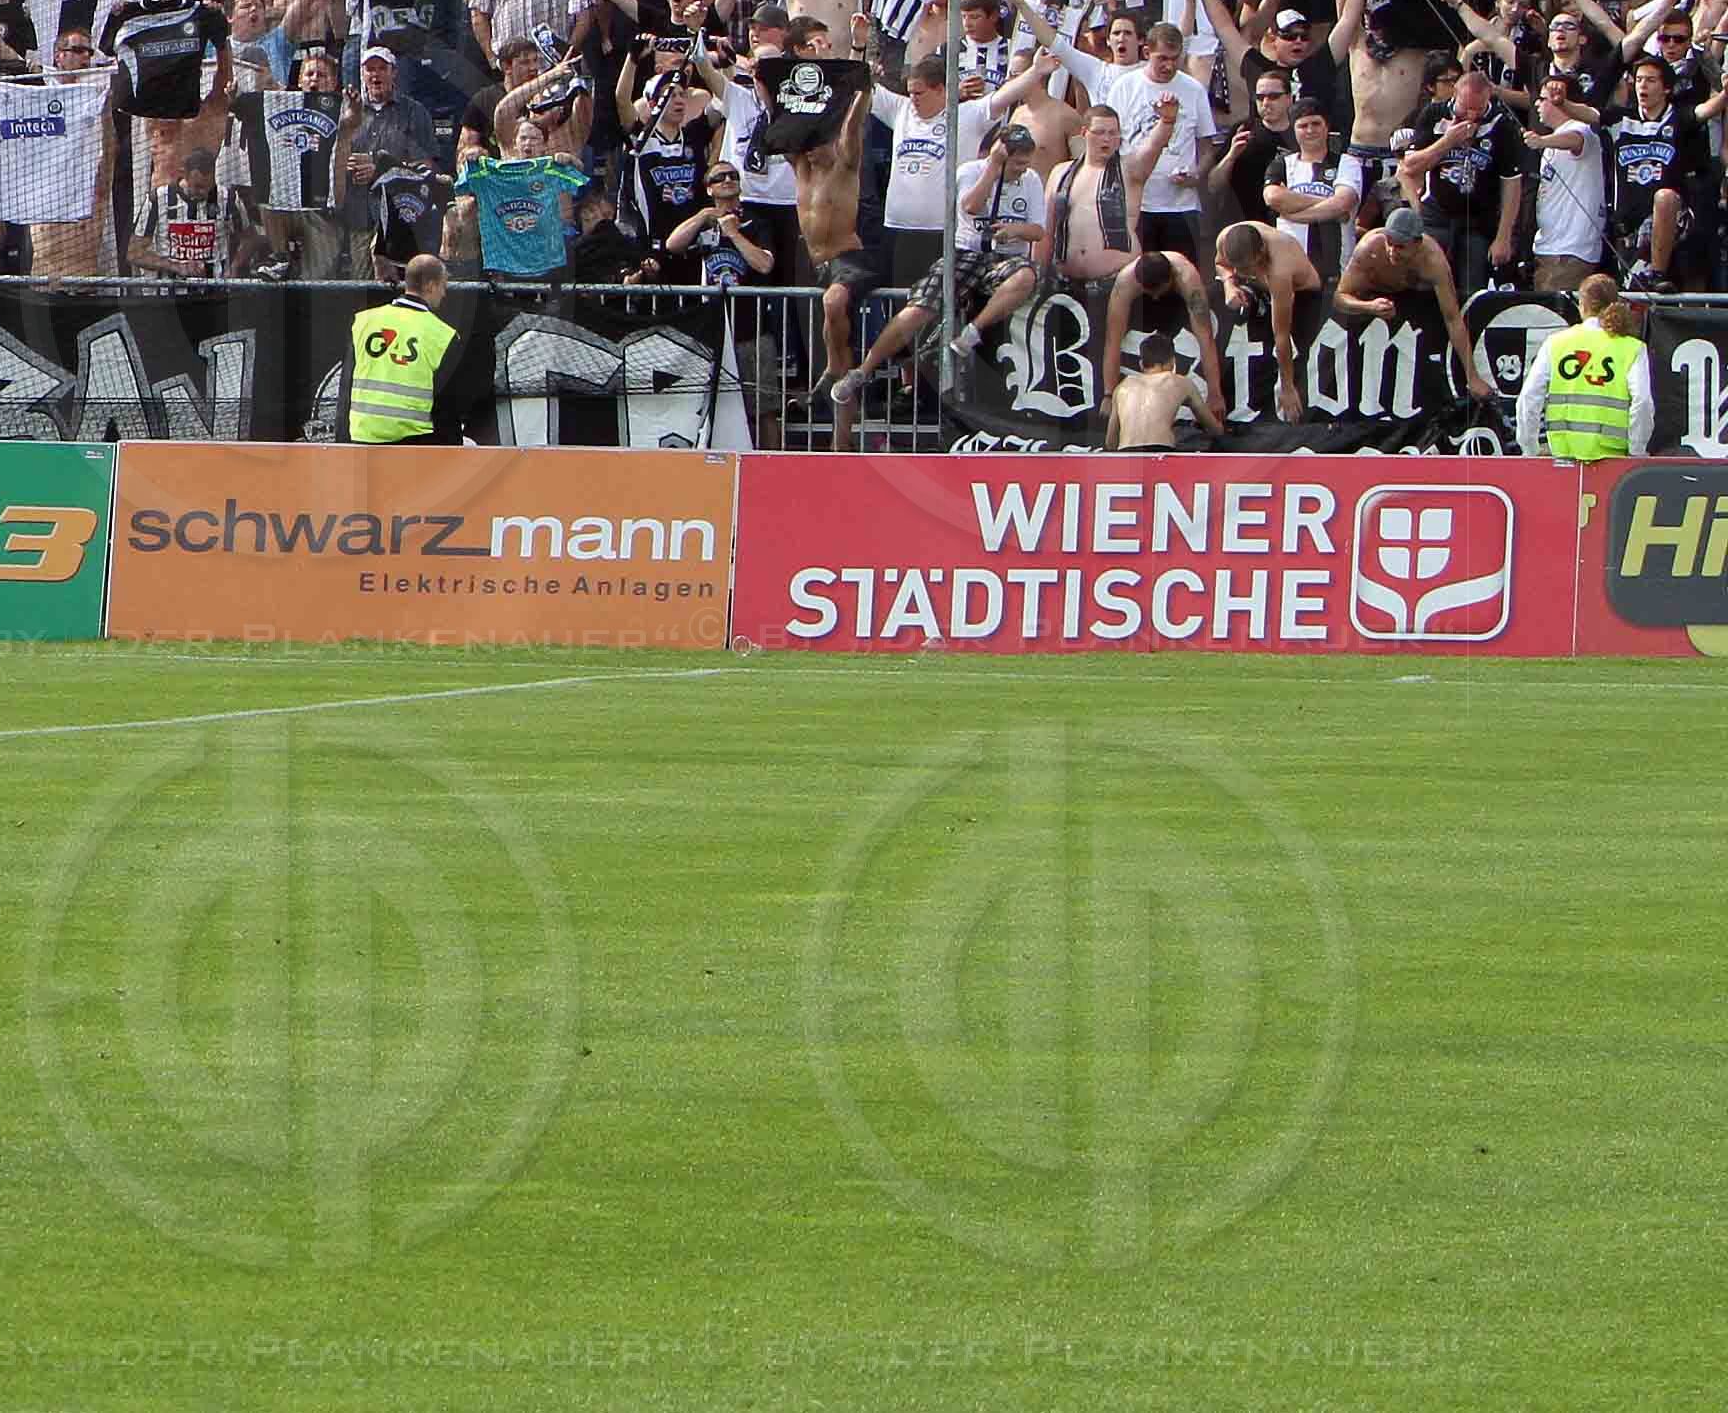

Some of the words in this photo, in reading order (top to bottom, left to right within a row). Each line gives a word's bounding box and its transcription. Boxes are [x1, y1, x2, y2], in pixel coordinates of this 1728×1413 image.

[270, 111, 338, 136] PUNTIGAMER
[969, 481, 1336, 555] WIENER
[357, 570, 561, 597] Elektrische
[572, 574, 716, 601] Anlagen
[784, 566, 1330, 641] STÄDTISCHE
